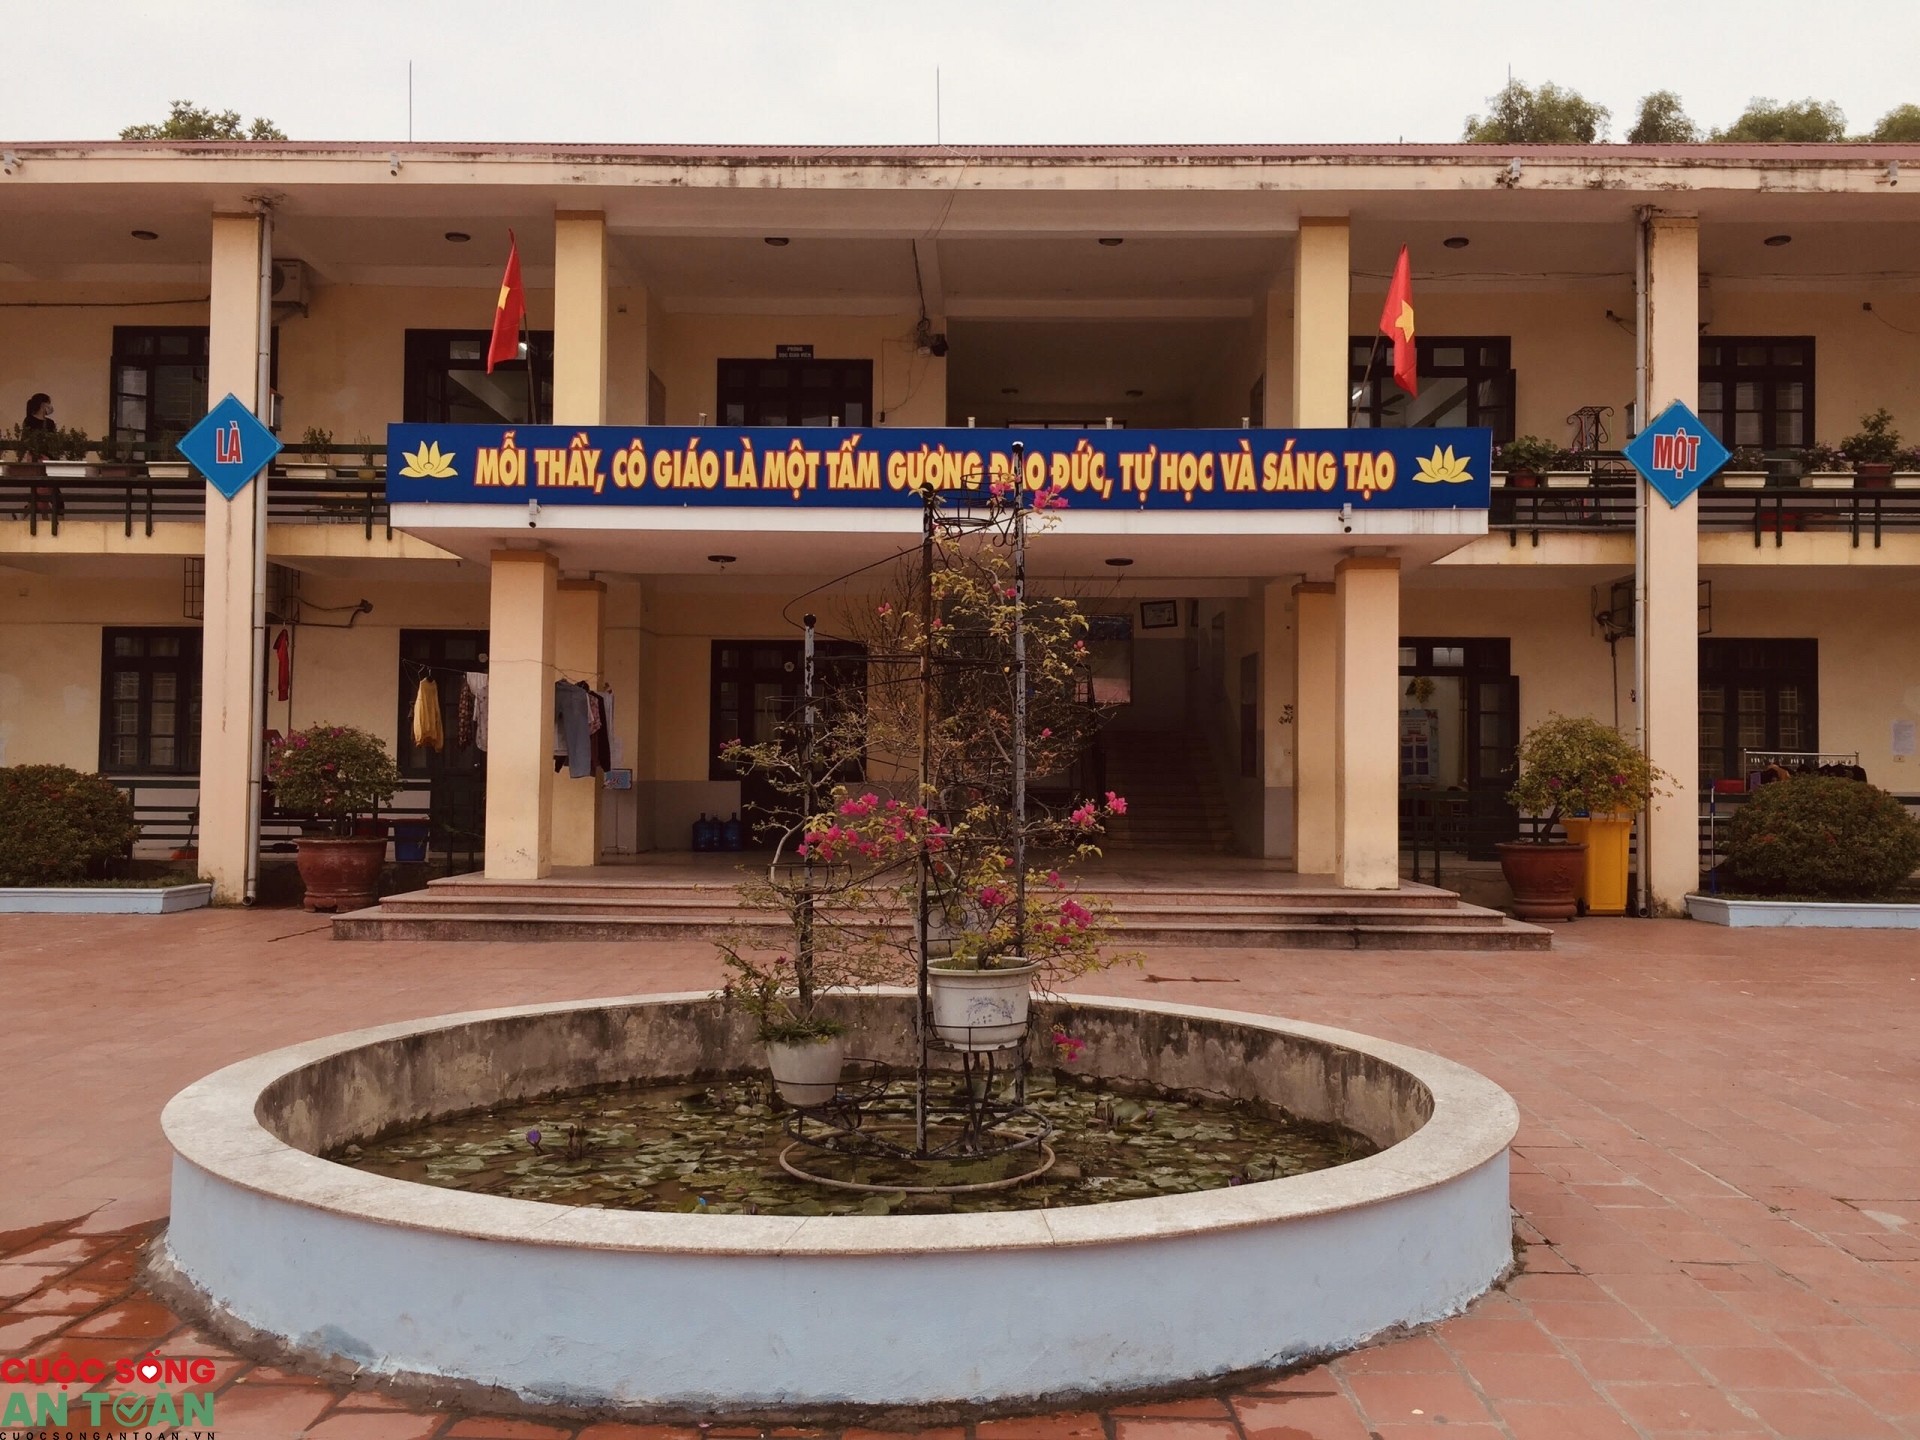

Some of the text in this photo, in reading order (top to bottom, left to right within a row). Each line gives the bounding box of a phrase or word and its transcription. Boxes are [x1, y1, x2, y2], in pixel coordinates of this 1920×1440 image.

[216, 420, 243, 464] LÀ
[474, 431, 527, 487] MỖI
[533, 432, 606, 494] THẦY,
[611, 438, 648, 489] CÔ
[651, 437, 721, 490] GIÁO
[723, 437, 762, 490] LÀ
[762, 438, 819, 500] MỘT
[823, 434, 883, 490] TẤM
[886, 443, 984, 492] GƯƠNG
[1050, 438, 1114, 500] ĐỨC,
[1118, 444, 1157, 502] TỰ
[1158, 450, 1215, 502] HỌC
[1219, 438, 1259, 492] VÀ
[1260, 438, 1338, 492] SÁNG
[1343, 450, 1397, 501] TẠO
[1652, 427, 1701, 479] MỘT
